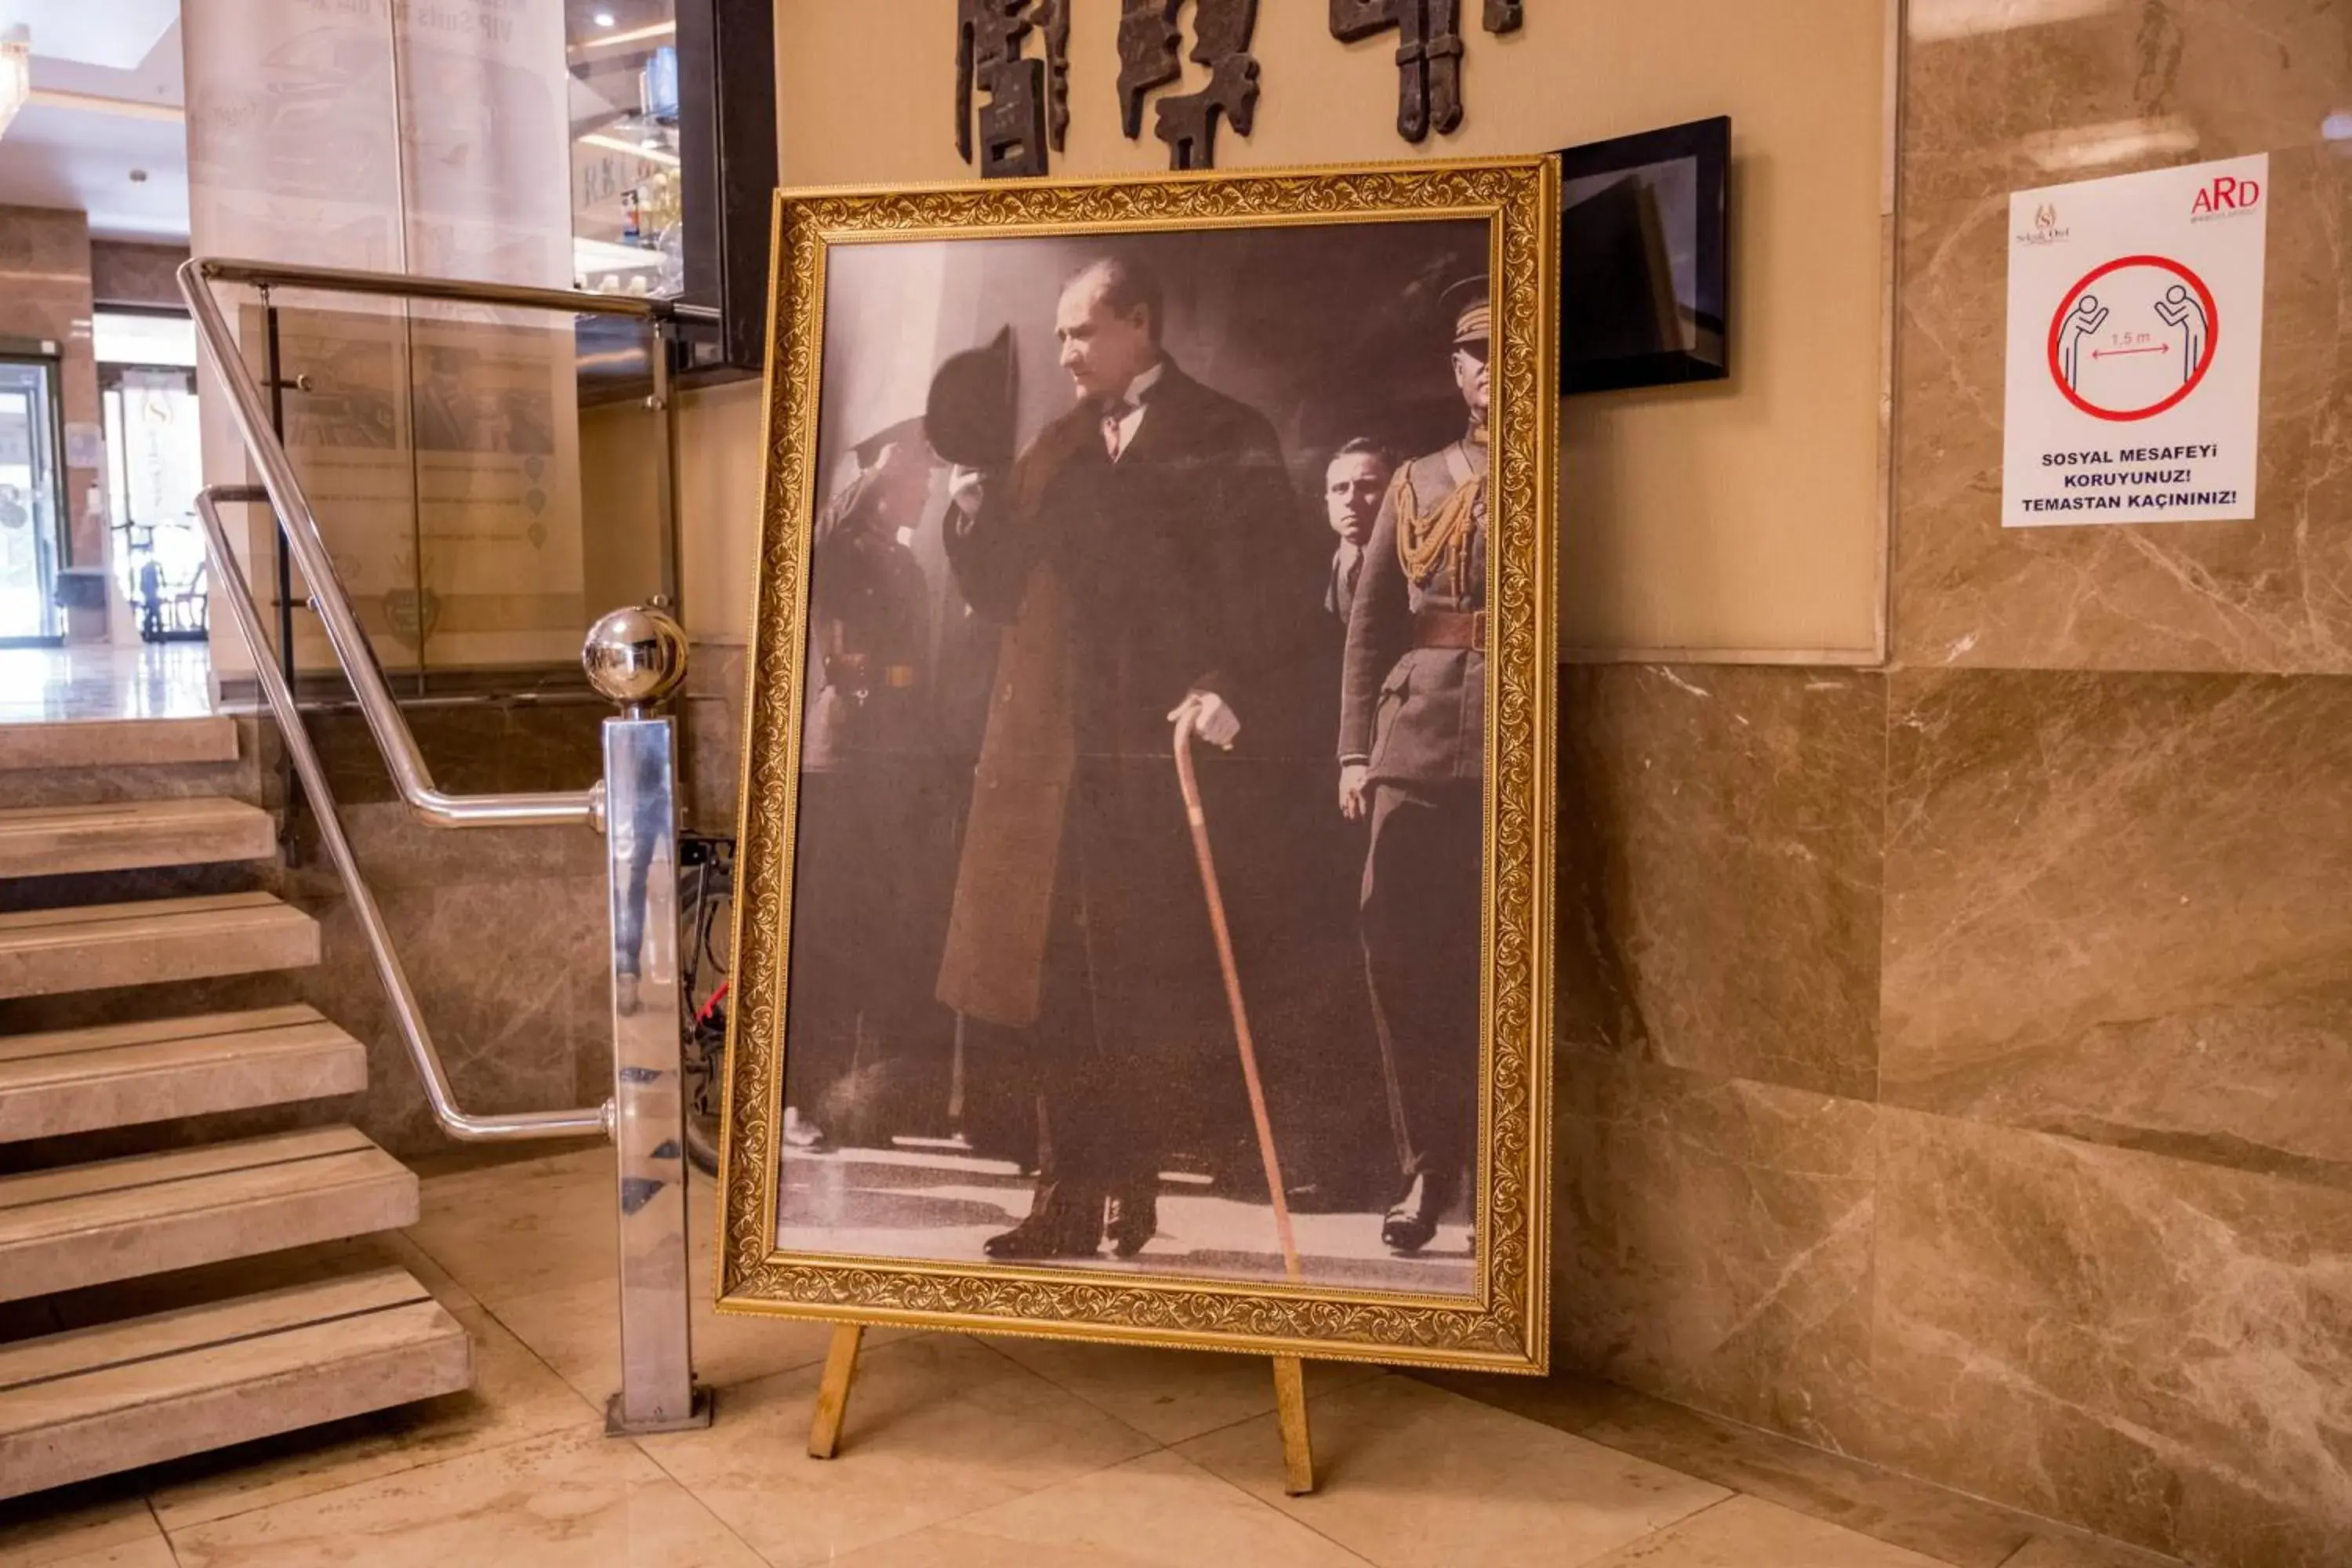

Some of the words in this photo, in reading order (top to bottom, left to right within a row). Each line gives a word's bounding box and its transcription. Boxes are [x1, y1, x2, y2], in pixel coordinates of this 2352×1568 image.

[2190, 176, 2259, 215] ARD
[2136, 332, 2151, 343] m
[2042, 451, 2114, 466] SOSYAL
[2064, 469, 2191, 488] KORUYUNUZ!
[2022, 495, 2121, 512] TEMASTAN
[2128, 490, 2237, 510] KAÇININIZ!
